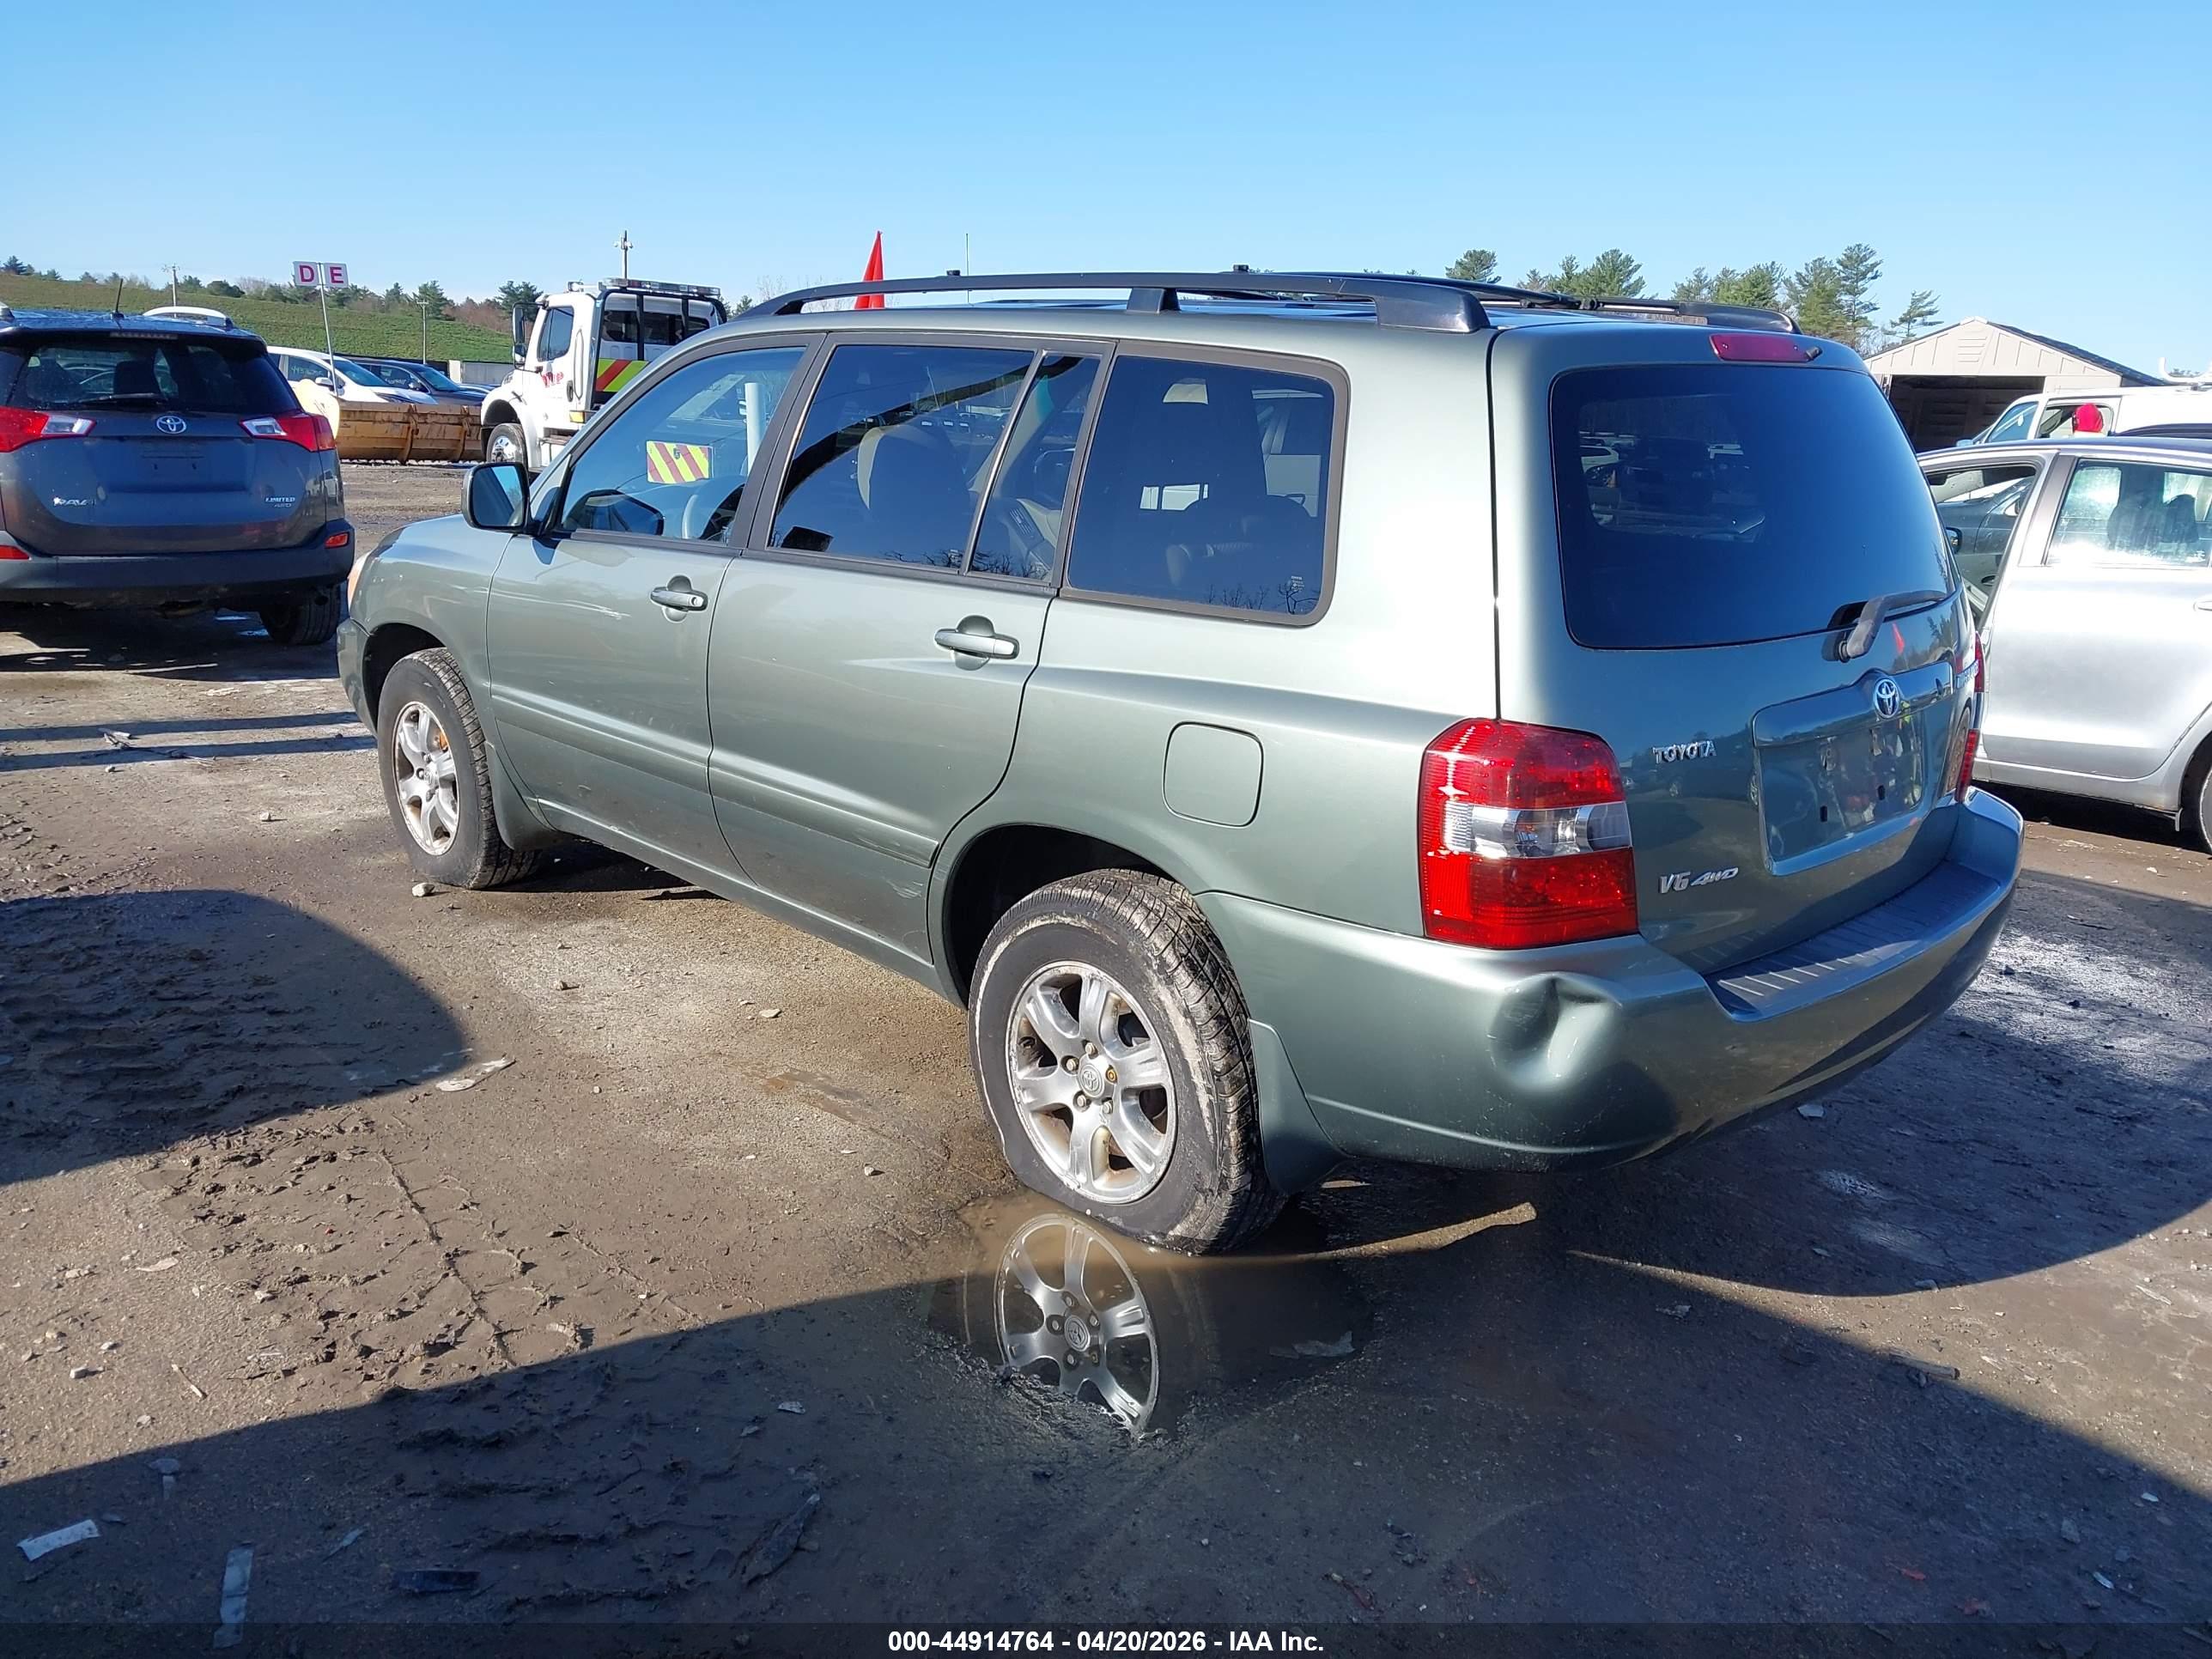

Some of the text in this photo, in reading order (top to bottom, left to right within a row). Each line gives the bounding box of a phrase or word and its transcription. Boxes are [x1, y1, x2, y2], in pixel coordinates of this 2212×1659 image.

[299, 264, 315, 283] D
[329, 266, 344, 284] E
[53, 497, 96, 507] RAV
[1652, 740, 1717, 764] TOYOTA
[1659, 866, 1739, 894] V6 4WD
